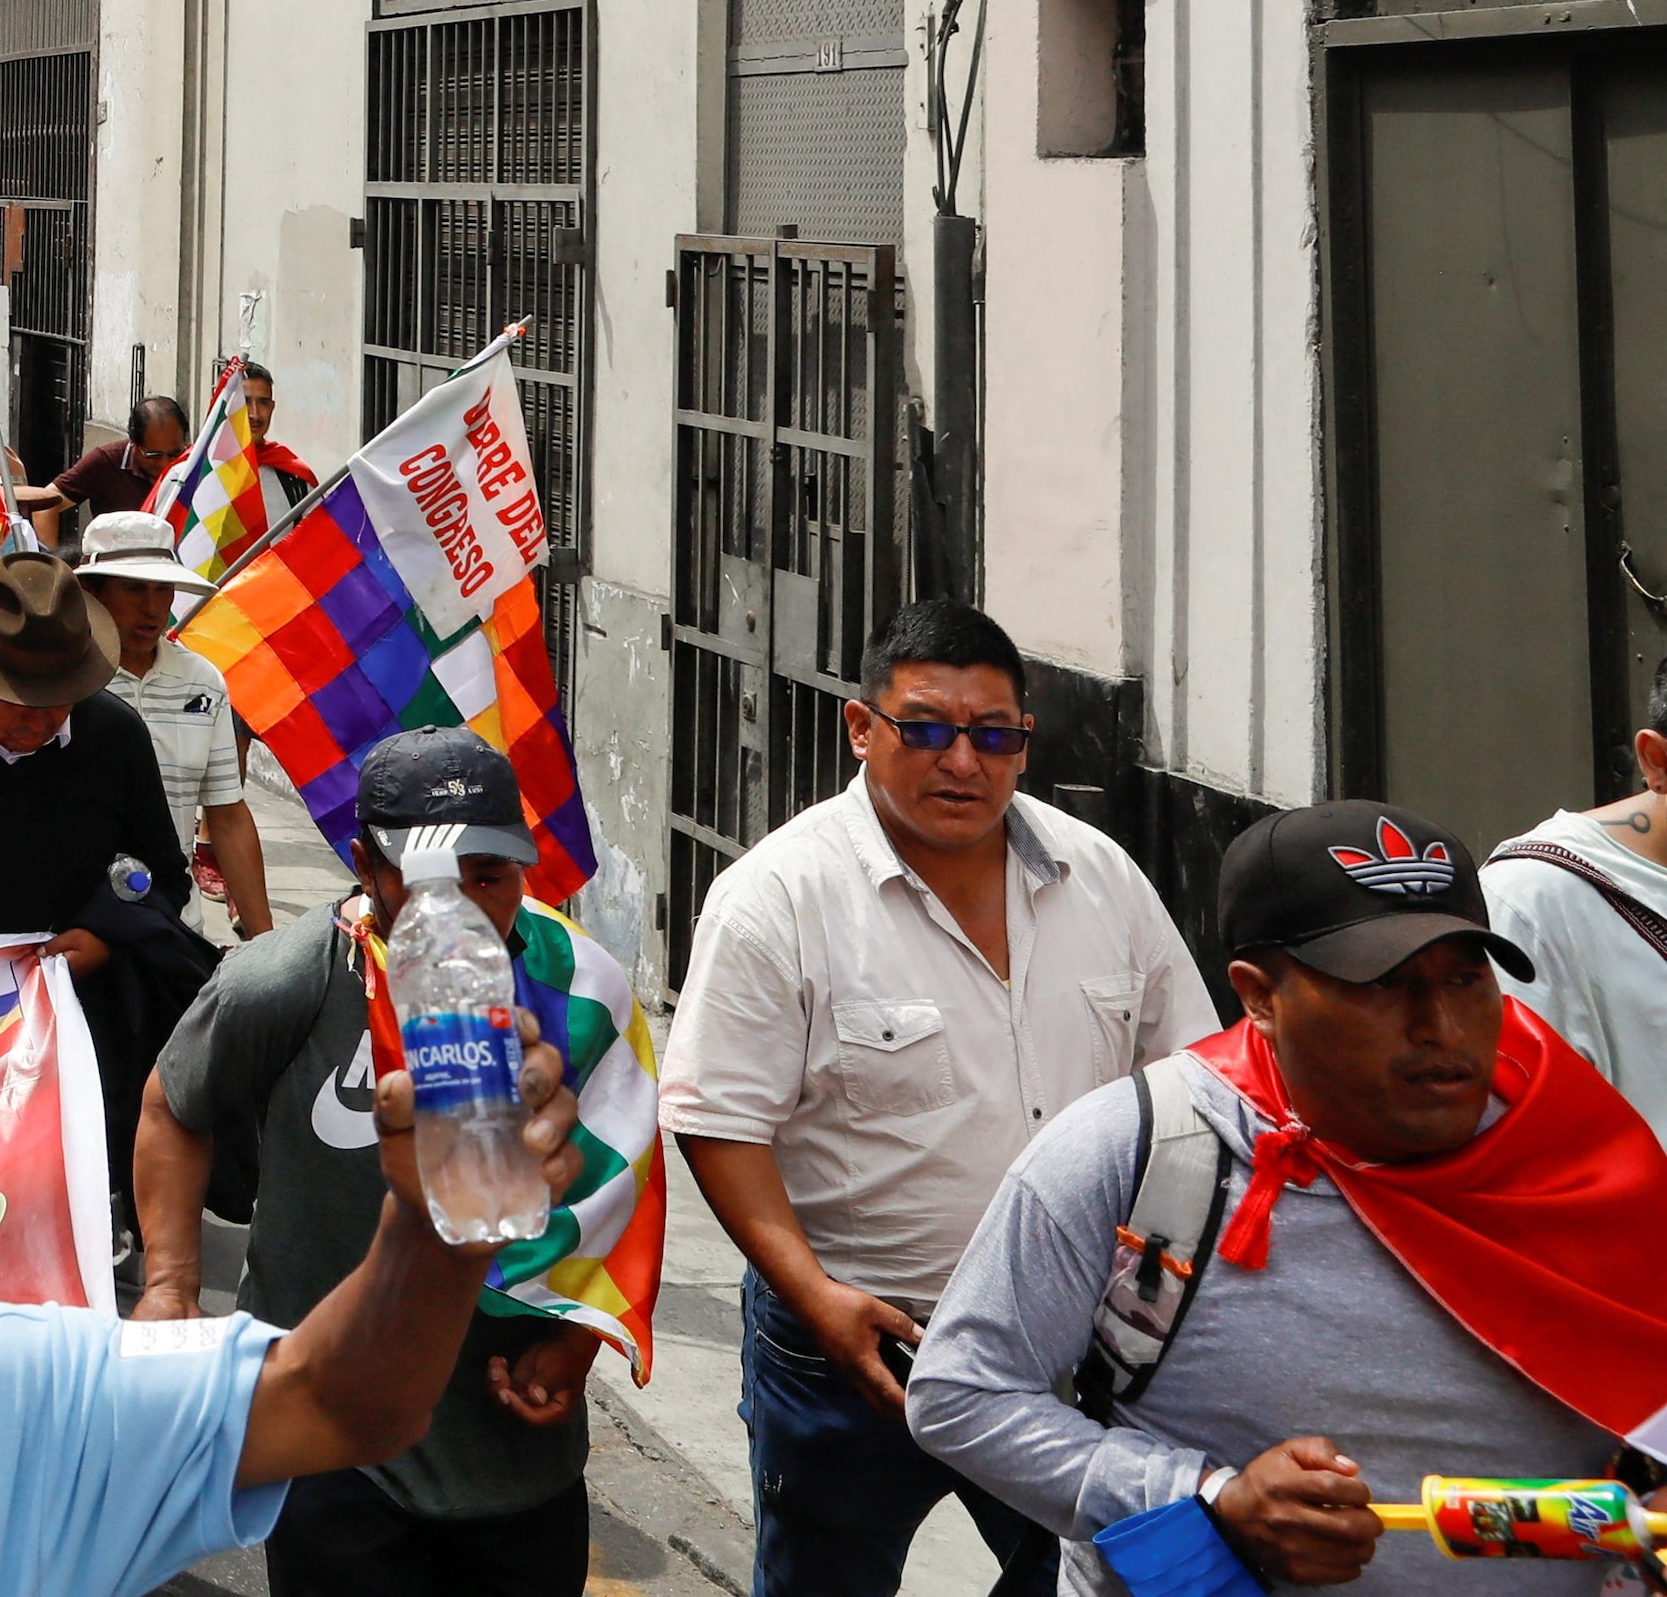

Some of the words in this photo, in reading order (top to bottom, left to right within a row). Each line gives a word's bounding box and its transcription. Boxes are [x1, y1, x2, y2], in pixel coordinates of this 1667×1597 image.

[818, 42, 837, 67] 191
[398, 443, 495, 599] CONGRESO
[495, 488, 547, 566] DEL
